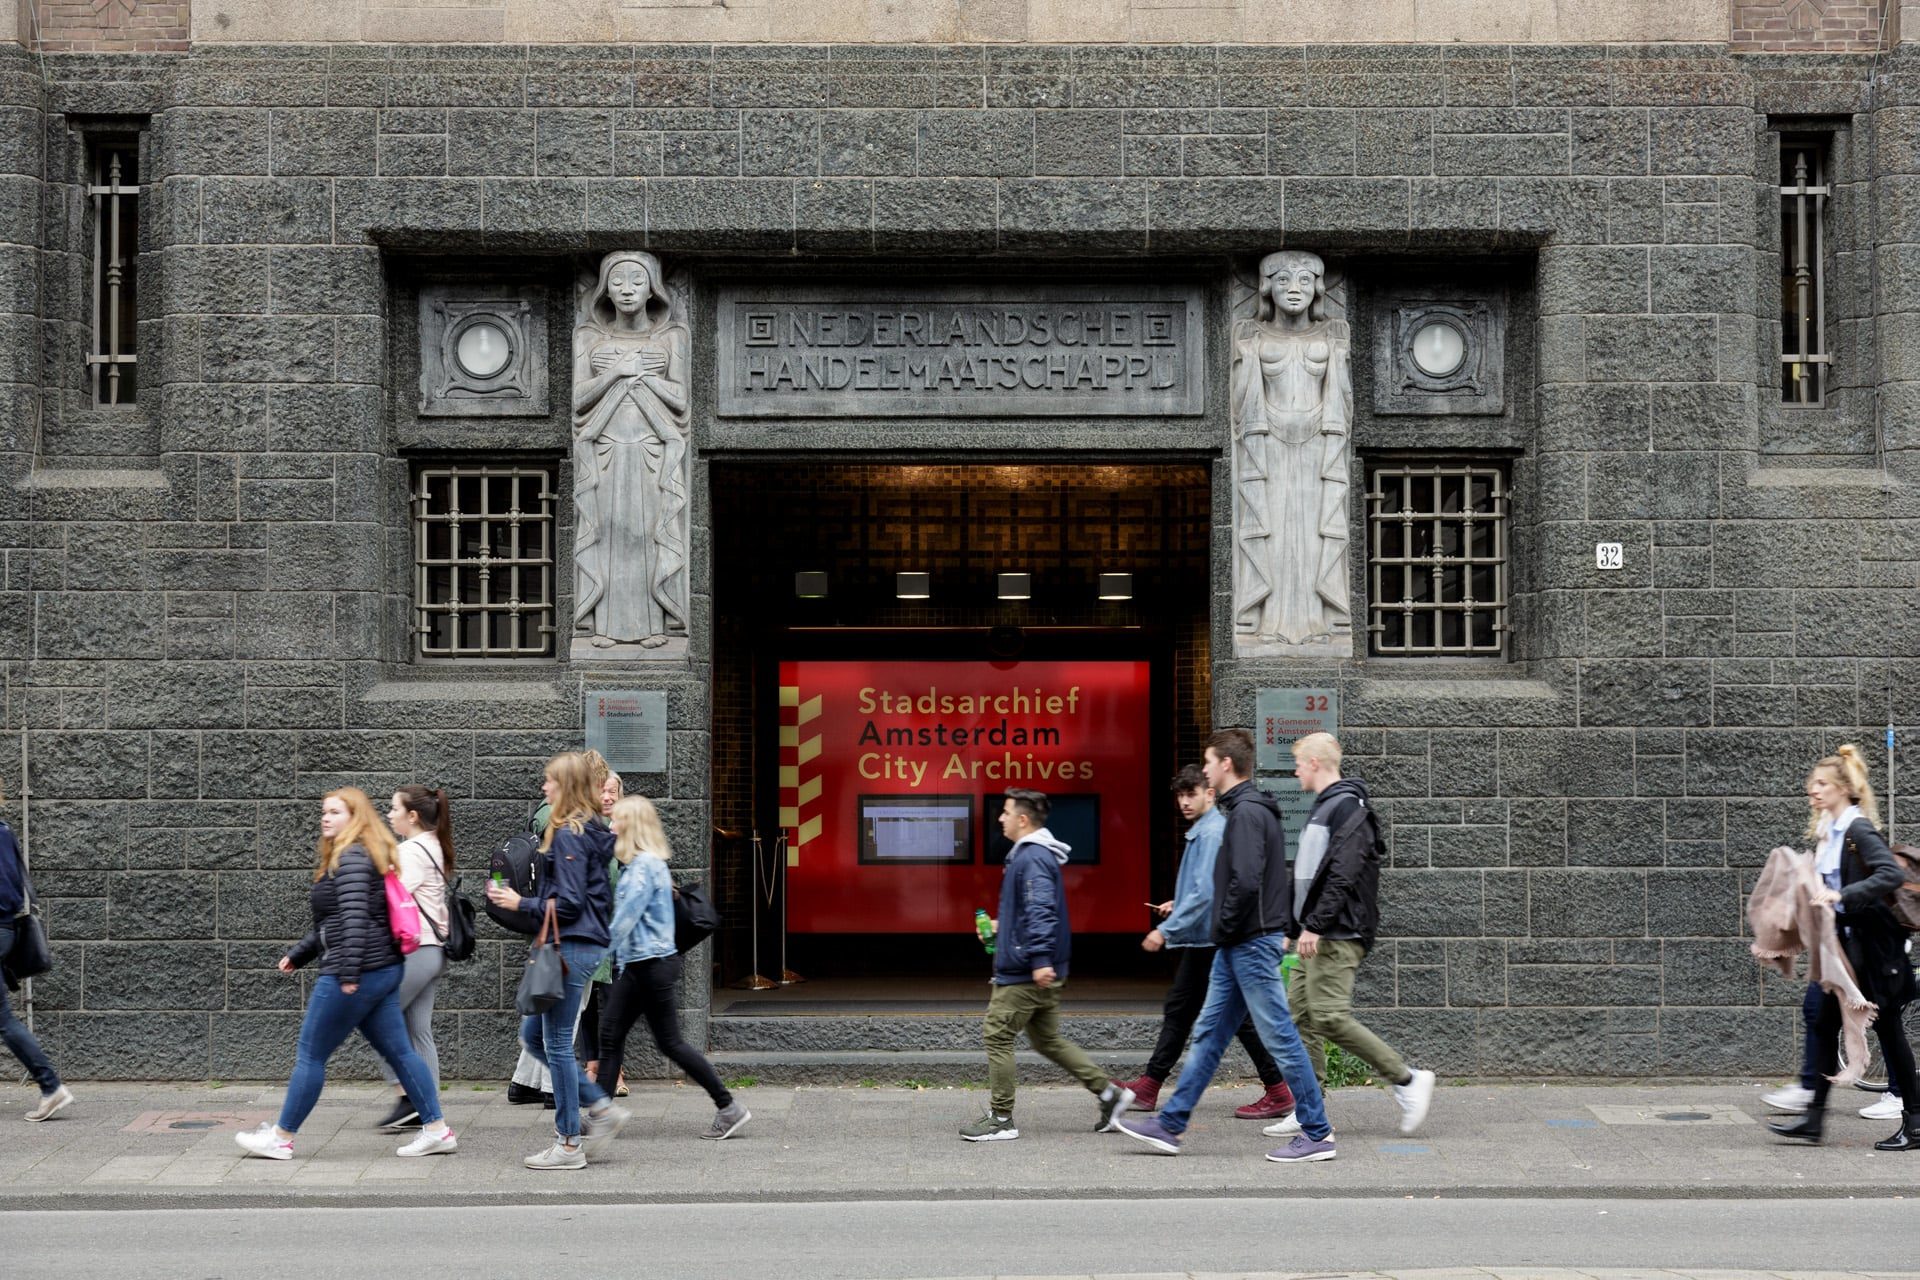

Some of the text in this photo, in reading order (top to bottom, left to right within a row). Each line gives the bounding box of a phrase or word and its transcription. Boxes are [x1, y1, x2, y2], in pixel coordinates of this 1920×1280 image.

[788, 312, 1132, 347] NEDERLANDSCHE
[745, 354, 1176, 390] HANDEL-MAATSCHAPPIJ
[1600, 546, 1620, 567] 32
[857, 686, 1080, 715] Stadsarchief
[1305, 696, 1329, 711] 32
[857, 719, 1061, 746] Amsterdam
[1277, 718, 1322, 726] Gemeente
[857, 751, 1094, 787] City Archives
